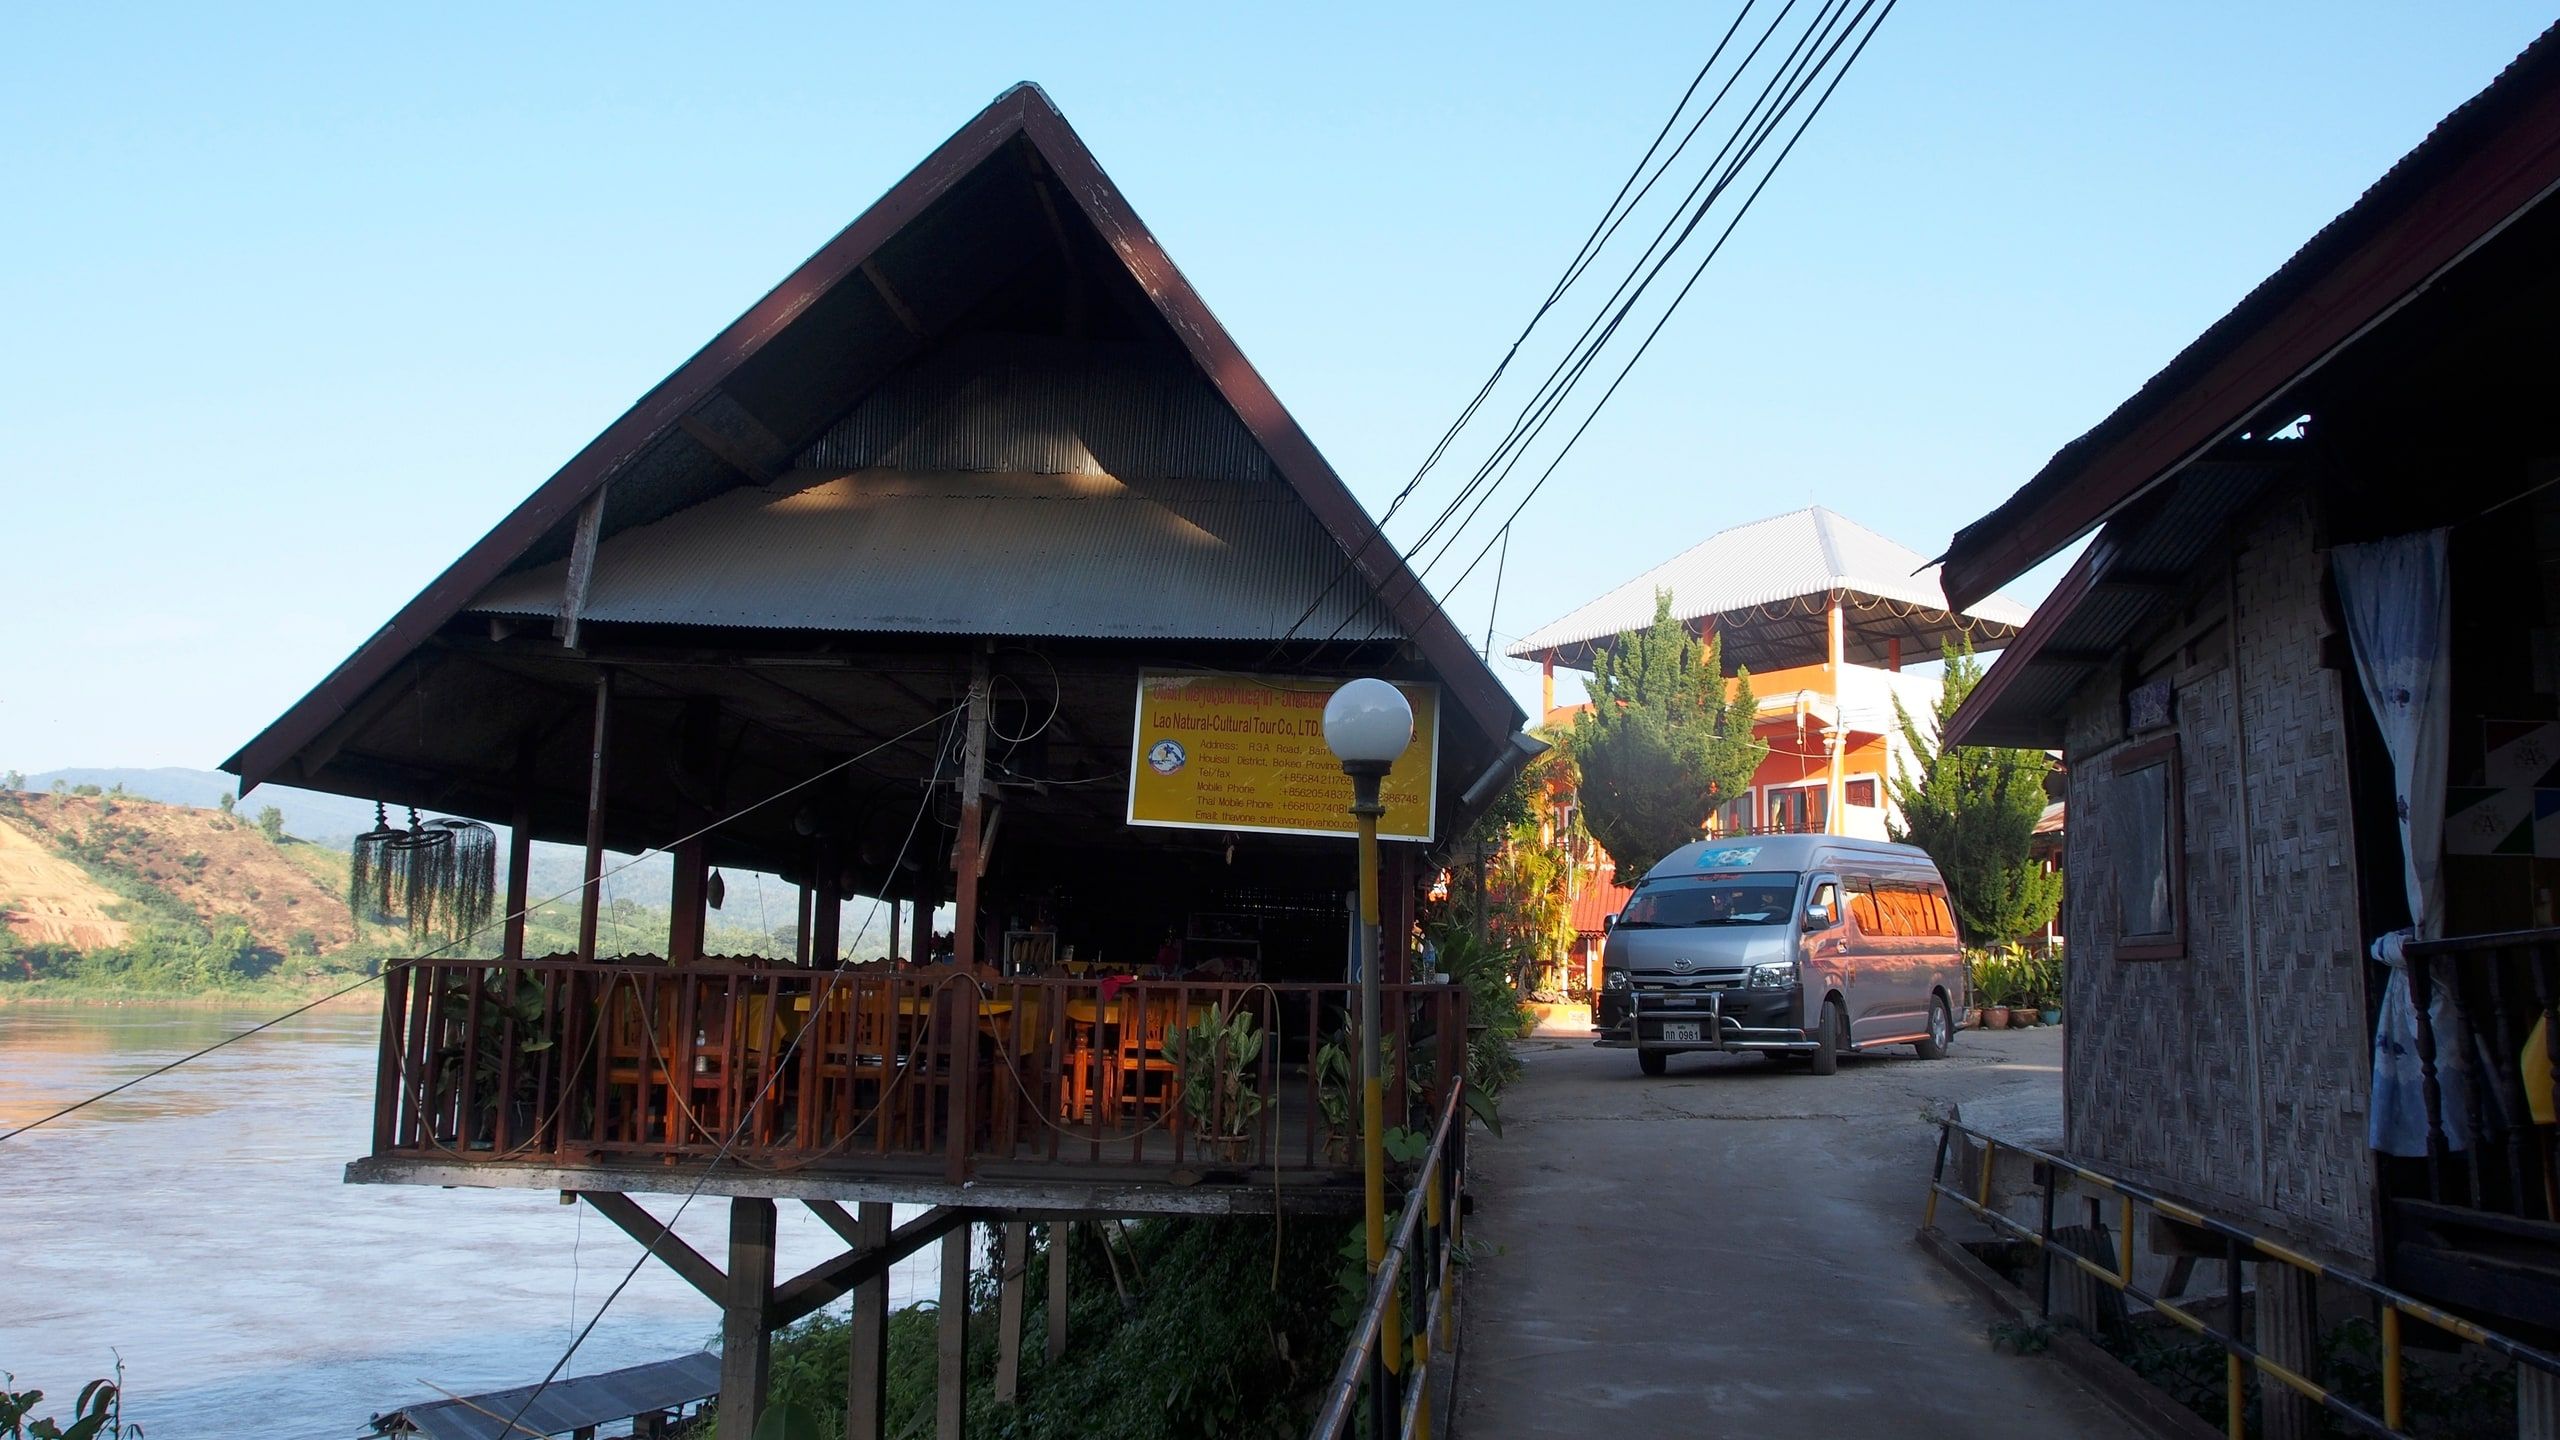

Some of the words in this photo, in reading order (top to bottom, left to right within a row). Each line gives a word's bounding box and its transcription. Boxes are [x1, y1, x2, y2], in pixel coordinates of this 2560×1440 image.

[1153, 711, 1171, 729] Lao
[1173, 712, 1252, 734] Natural-Cultural
[1253, 717, 1277, 735] Tour
[1277, 719, 1296, 737] Co.,
[1200, 740, 1239, 751] Address:
[1308, 746, 1327, 755] Ban
[1273, 758, 1302, 768] Bokeo
[1199, 767, 1231, 778] Tel/fax
[1197, 781, 1223, 792] Mobile
[1227, 784, 1256, 794] Phone
[1218, 797, 1244, 808] Mobile
[1246, 800, 1274, 809] Phone
